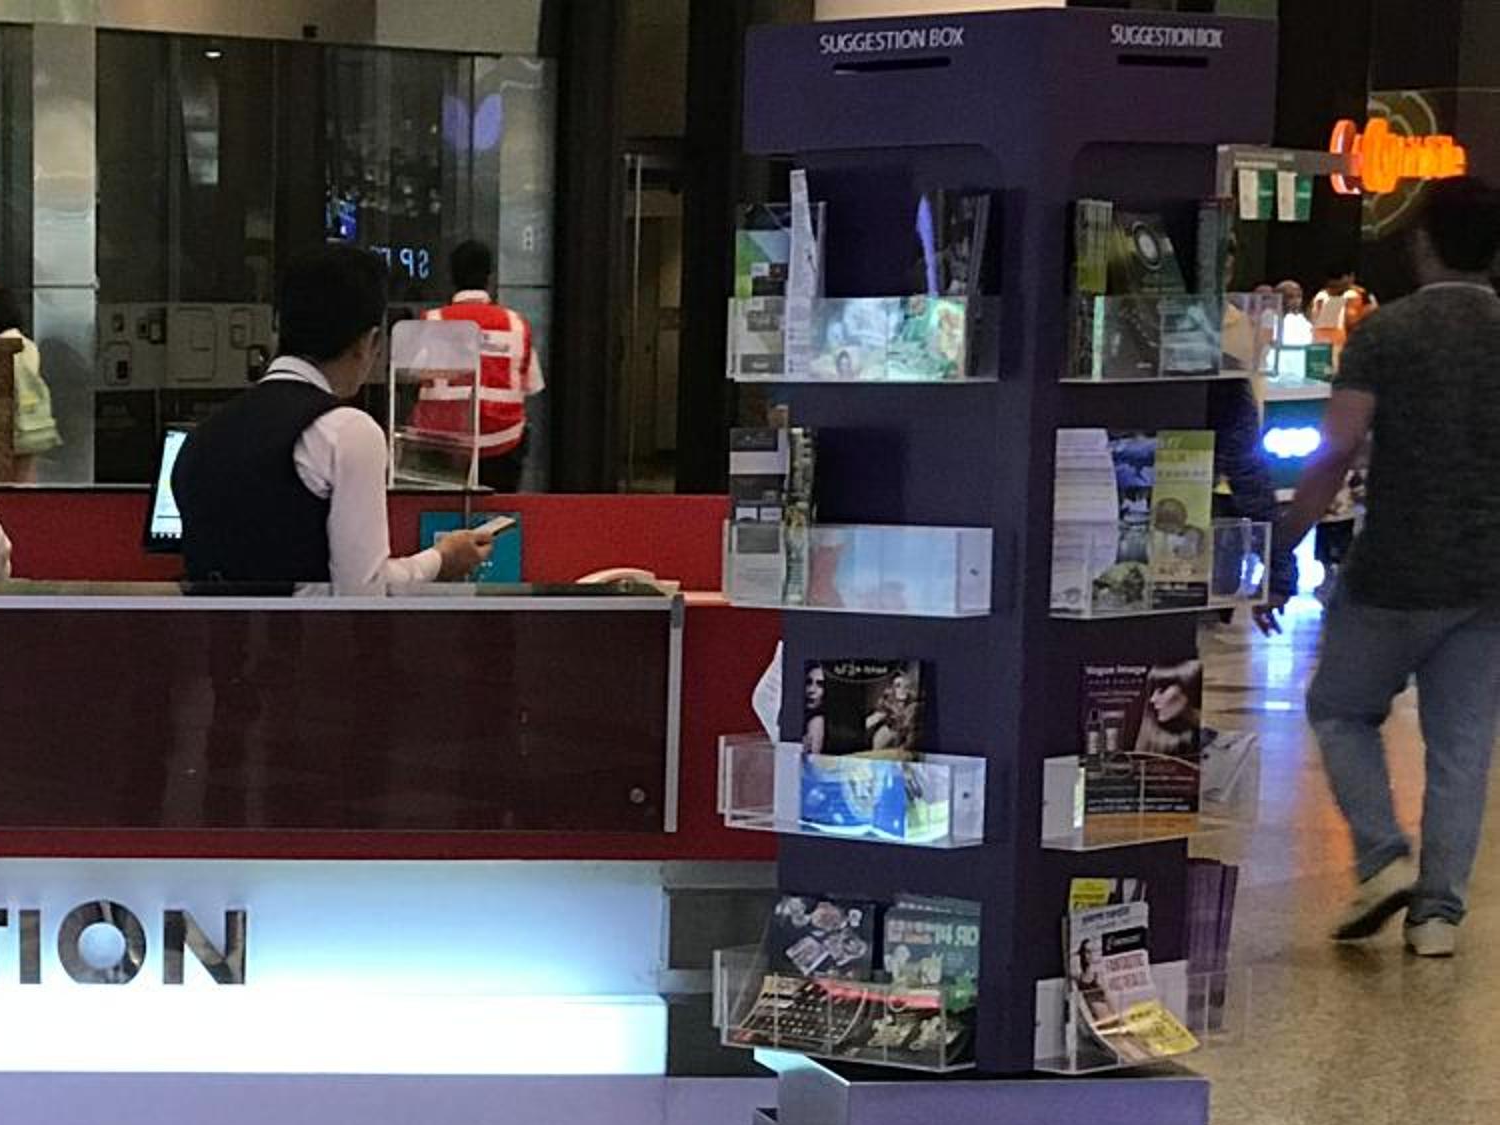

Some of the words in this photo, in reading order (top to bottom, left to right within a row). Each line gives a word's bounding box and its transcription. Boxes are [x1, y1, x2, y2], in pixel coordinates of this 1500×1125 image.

[820, 29, 926, 54] SUGGESTION
[930, 27, 965, 48] BOX
[1111, 25, 1194, 48] SUGGESTION
[1196, 28, 1223, 49] BOX
